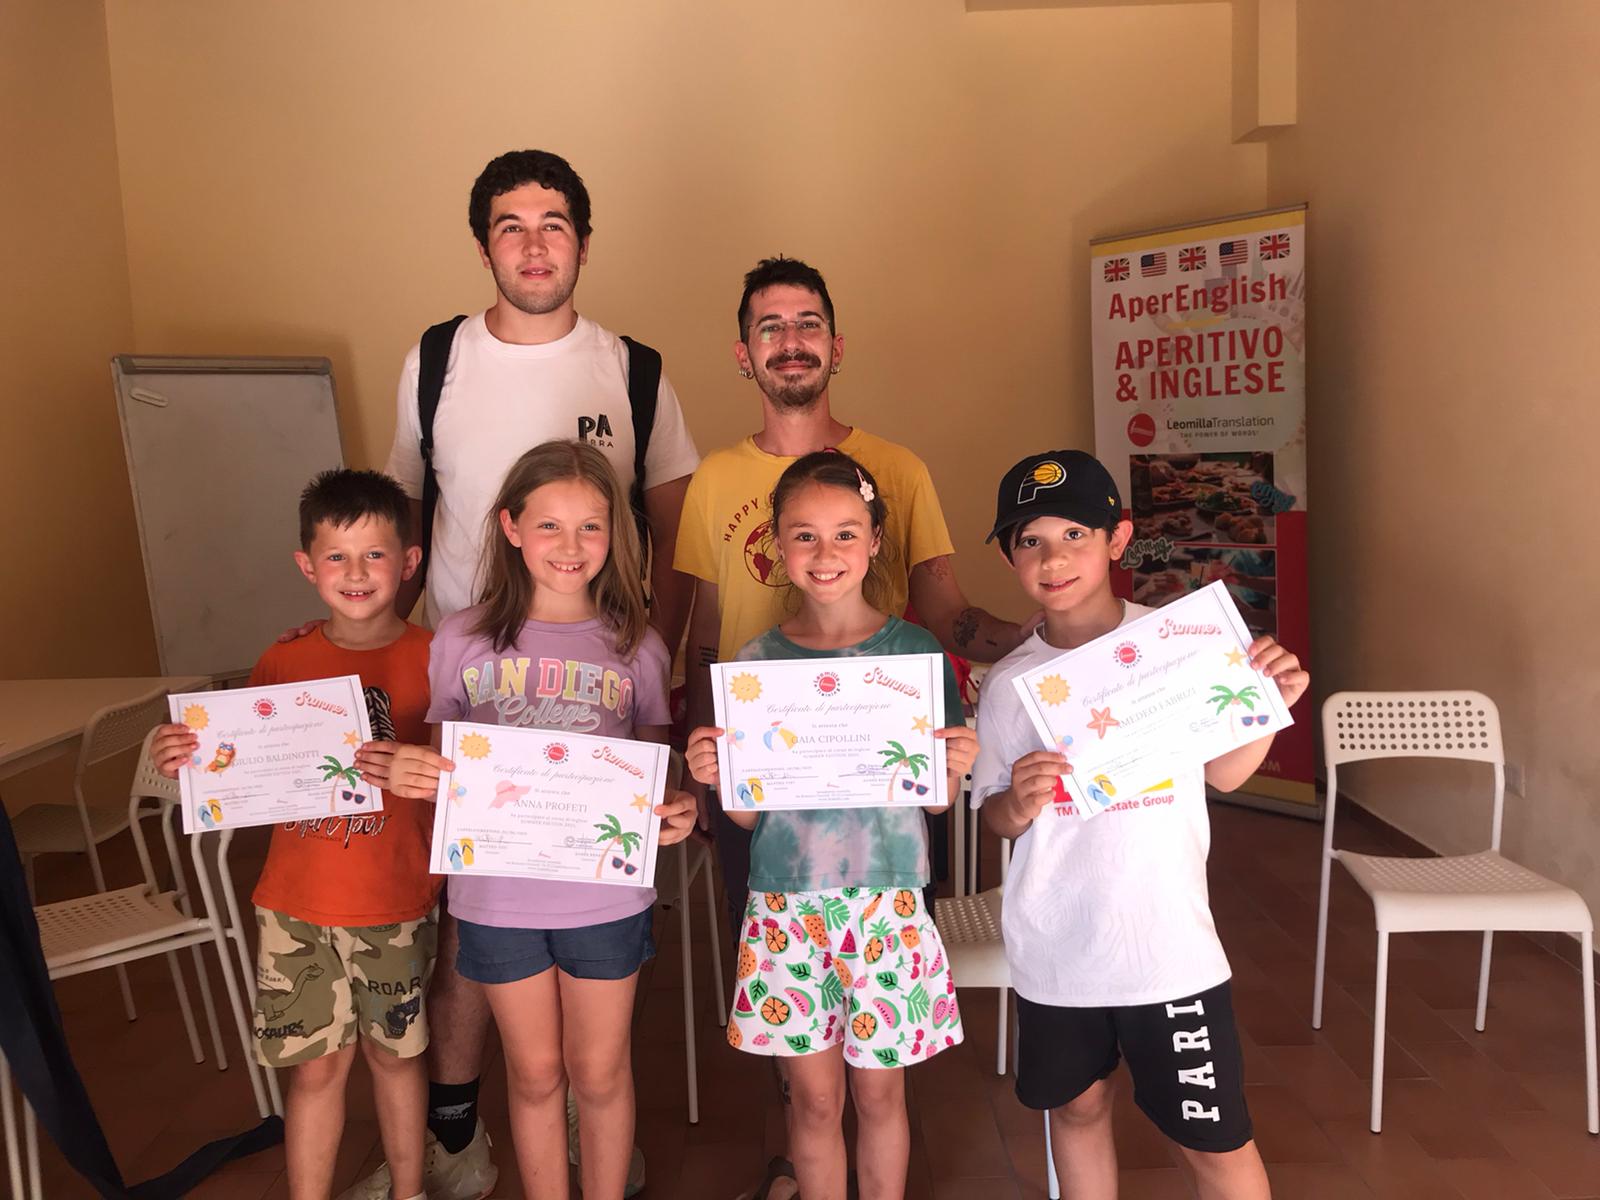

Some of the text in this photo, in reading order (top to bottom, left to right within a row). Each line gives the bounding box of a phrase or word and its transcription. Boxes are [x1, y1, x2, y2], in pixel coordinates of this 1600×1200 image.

[1109, 274, 1286, 323] AperEnglish
[1115, 326, 1284, 370] APERITIVO
[1115, 361, 1285, 402] & INGLESE
[578, 413, 613, 442] PA
[1167, 416, 1275, 430] LeomillaTranslation
[724, 497, 759, 542] HAPPY
[1120, 537, 1175, 570] Learning
[1158, 618, 1223, 639] Summer
[463, 657, 531, 708] SAN
[536, 657, 634, 720] DIEGO
[863, 666, 921, 699] Summer
[296, 690, 348, 717] Summer
[494, 694, 601, 732] College
[824, 702, 892, 715] partecipazione
[792, 733, 871, 744] GAIA CIPOLLINI
[266, 750, 320, 763] BALDINOTTI
[591, 746, 645, 779] Summer
[513, 800, 588, 814] ANNA PROFETI
[1054, 806, 1073, 817] TM
[1143, 794, 1174, 807] Group
[368, 975, 422, 995] ROAR
[1165, 1000, 1220, 1122] PARI
